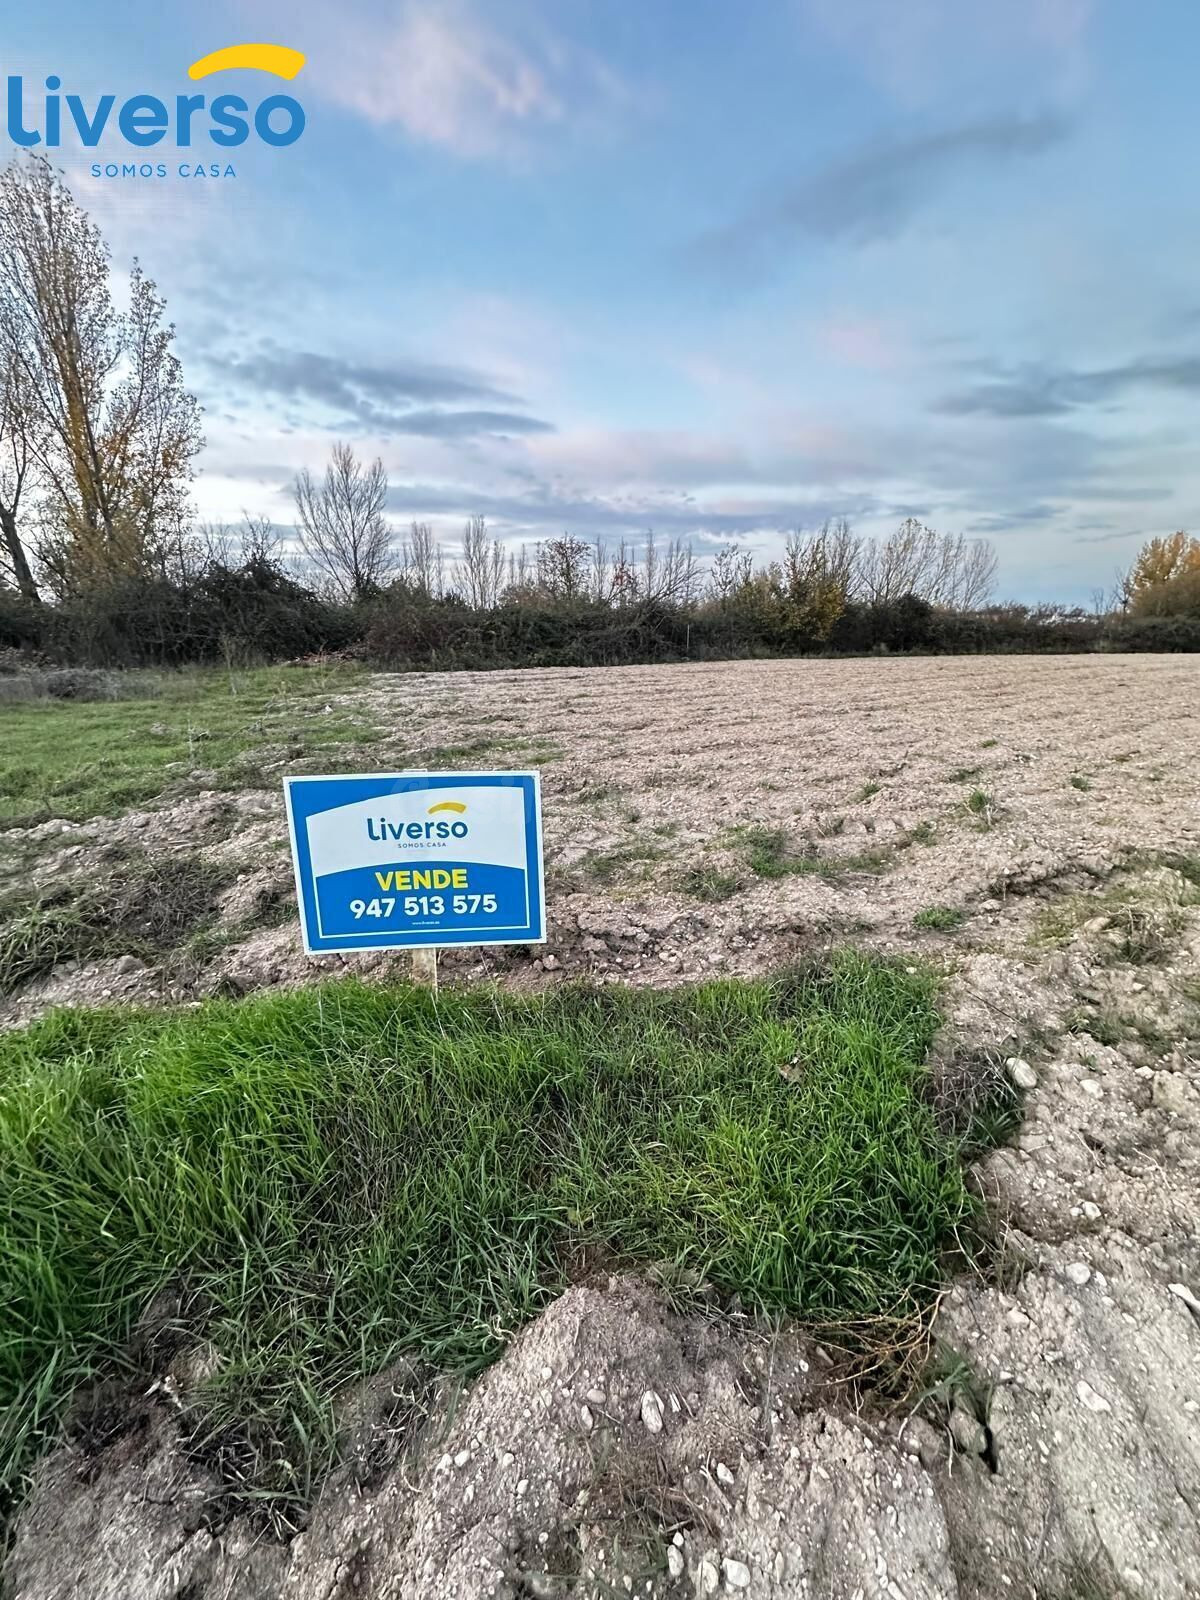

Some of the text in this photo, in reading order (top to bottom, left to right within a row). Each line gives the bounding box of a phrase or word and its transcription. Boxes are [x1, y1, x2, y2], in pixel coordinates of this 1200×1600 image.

[375, 868, 469, 892] VENDE
[350, 894, 498, 919] 947 513 575
